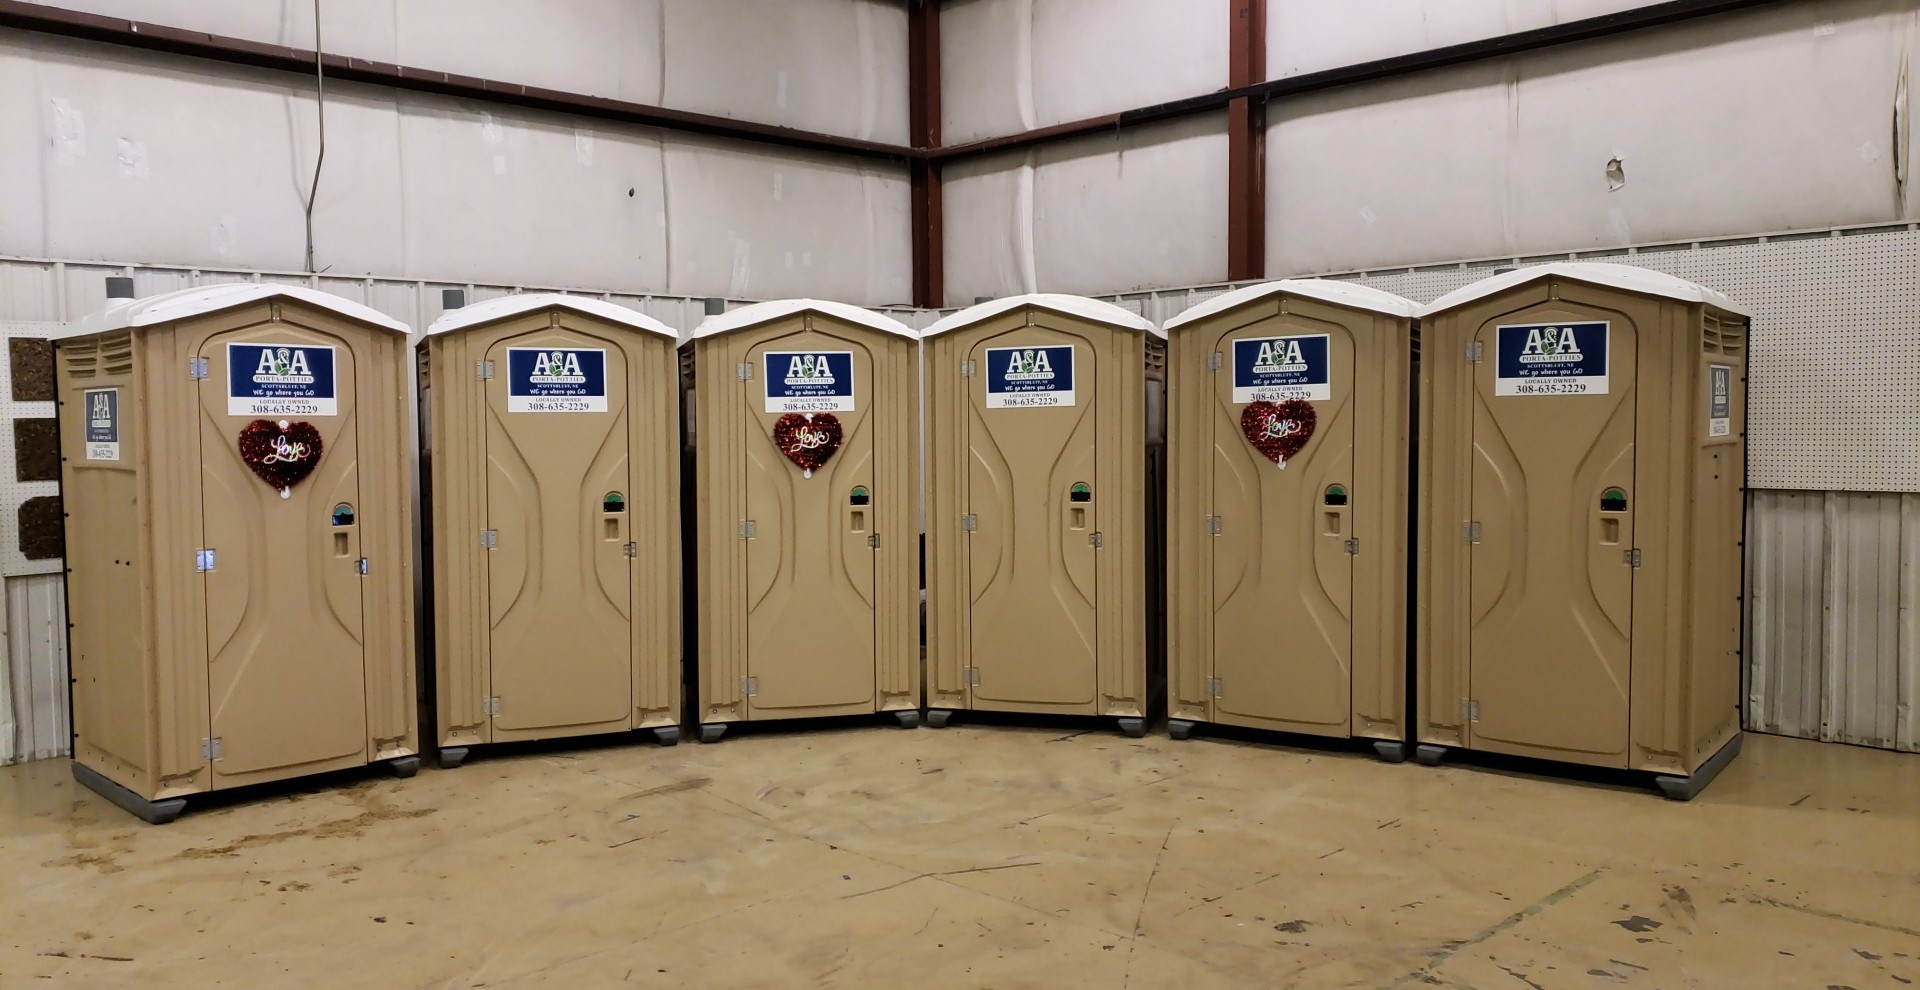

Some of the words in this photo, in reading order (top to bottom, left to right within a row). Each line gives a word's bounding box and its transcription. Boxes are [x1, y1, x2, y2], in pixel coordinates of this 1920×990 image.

[1256, 340, 1305, 365] A&A
[1523, 327, 1580, 355] A&A
[256, 348, 311, 376] A&A
[532, 352, 583, 376] A&A
[787, 355, 832, 378] A&A
[1007, 350, 1052, 373] A&A
[1251, 392, 1311, 401] 308-635-2229
[1516, 384, 1586, 393] 308-635-2229
[1003, 398, 1057, 406] 308-635-2229
[791, 426, 829, 452] Love
[1260, 414, 1301, 441] Love
[264, 435, 311, 464] Love
